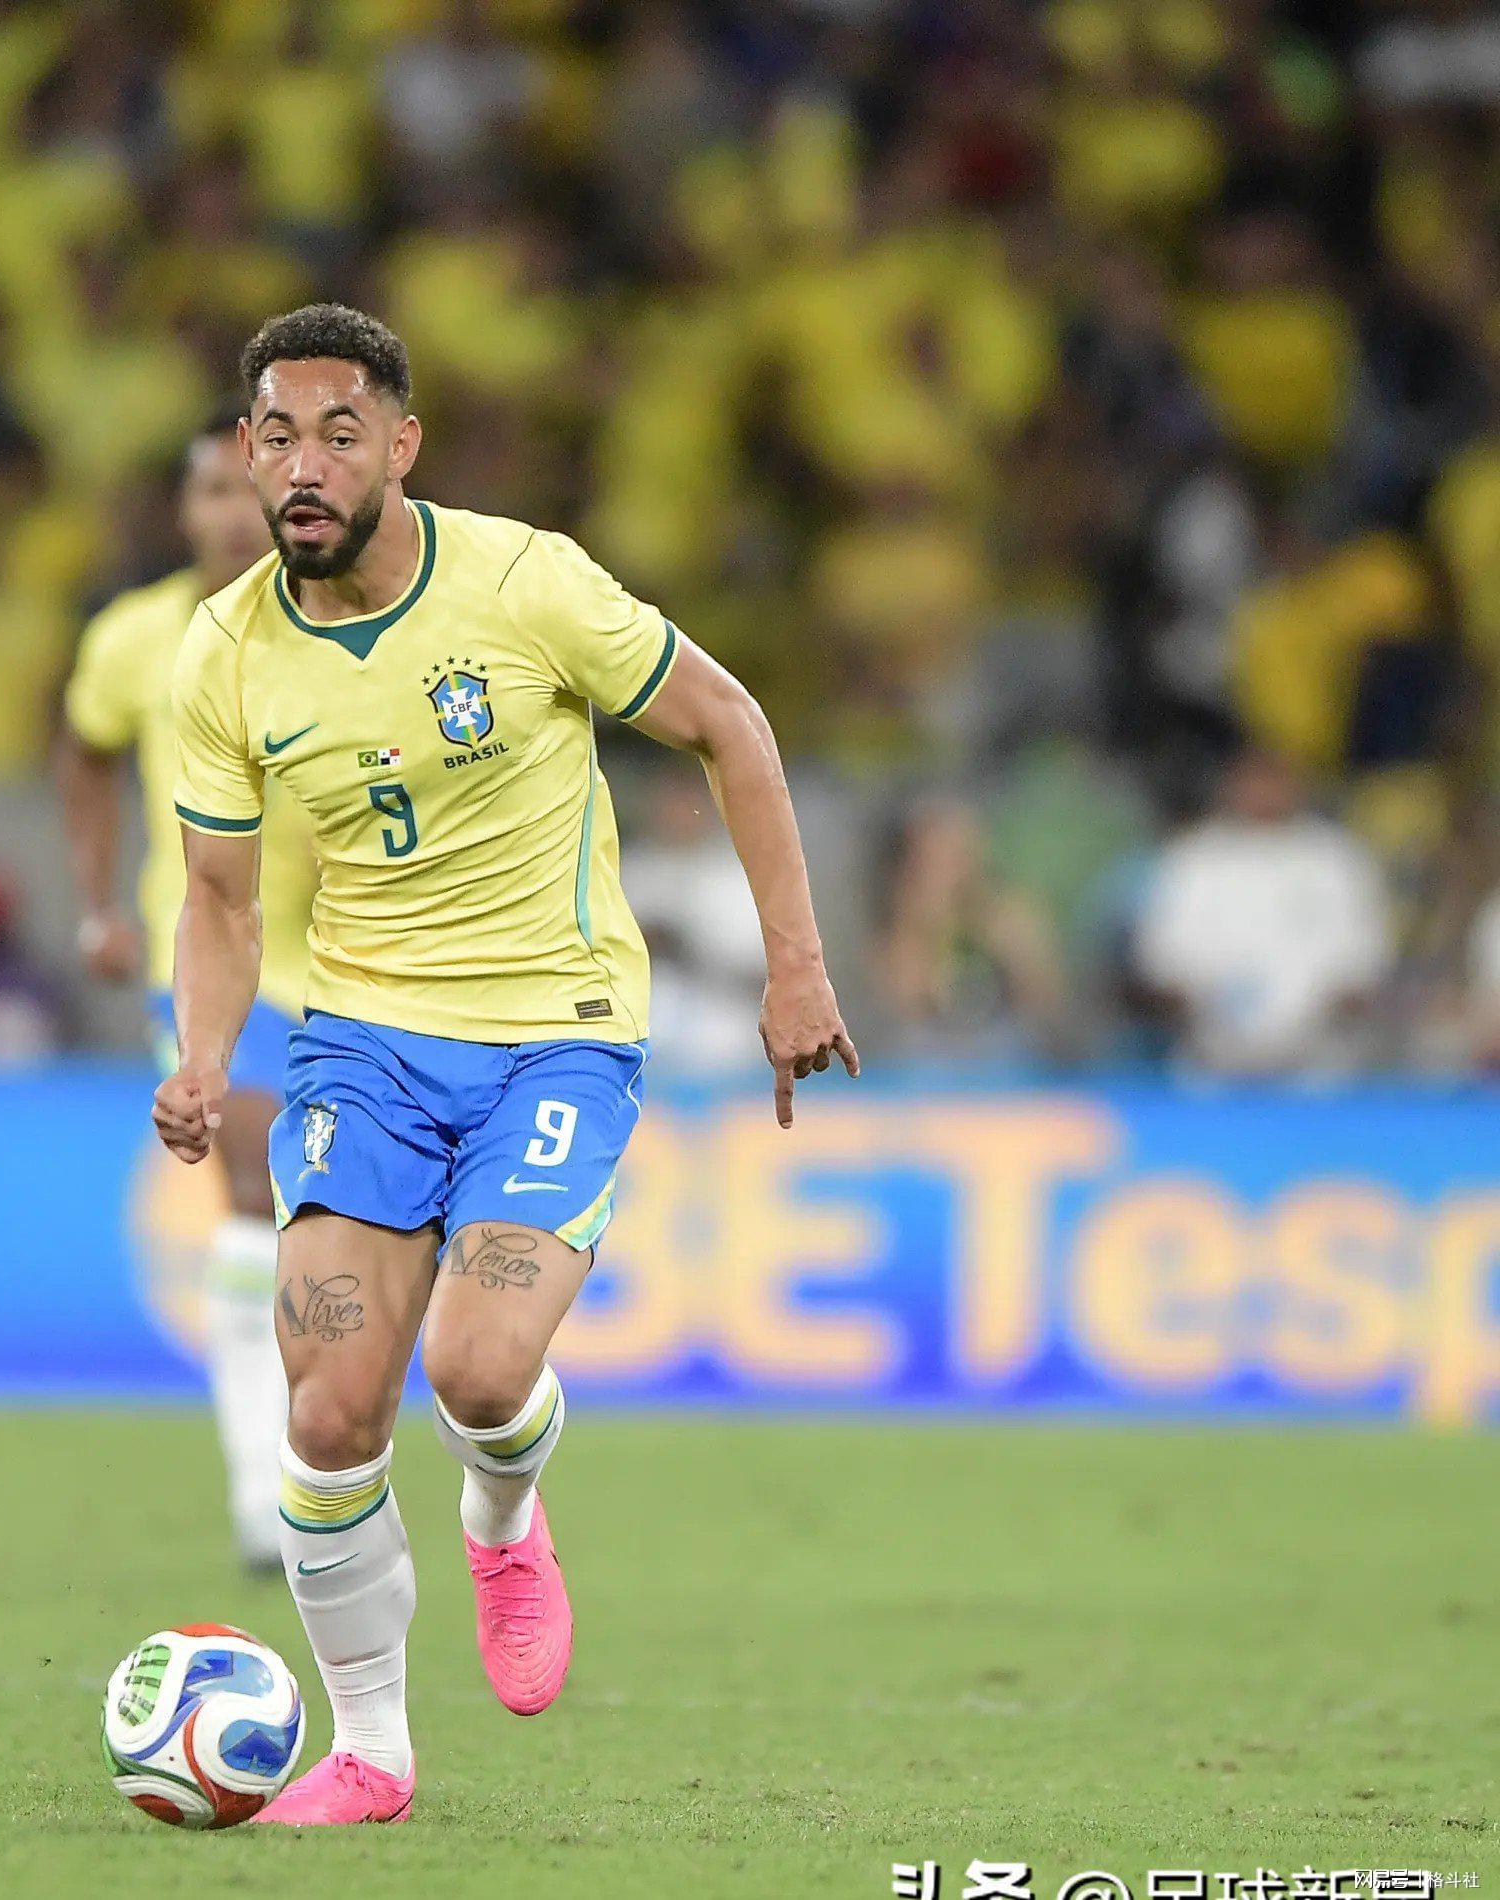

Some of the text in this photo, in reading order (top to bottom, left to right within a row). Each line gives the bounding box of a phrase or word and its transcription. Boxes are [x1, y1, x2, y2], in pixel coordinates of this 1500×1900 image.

[450, 700, 473, 715] CBF
[443, 742, 510, 770] BRASIL
[368, 783, 418, 858] 9
[523, 1099, 580, 1168] 9
